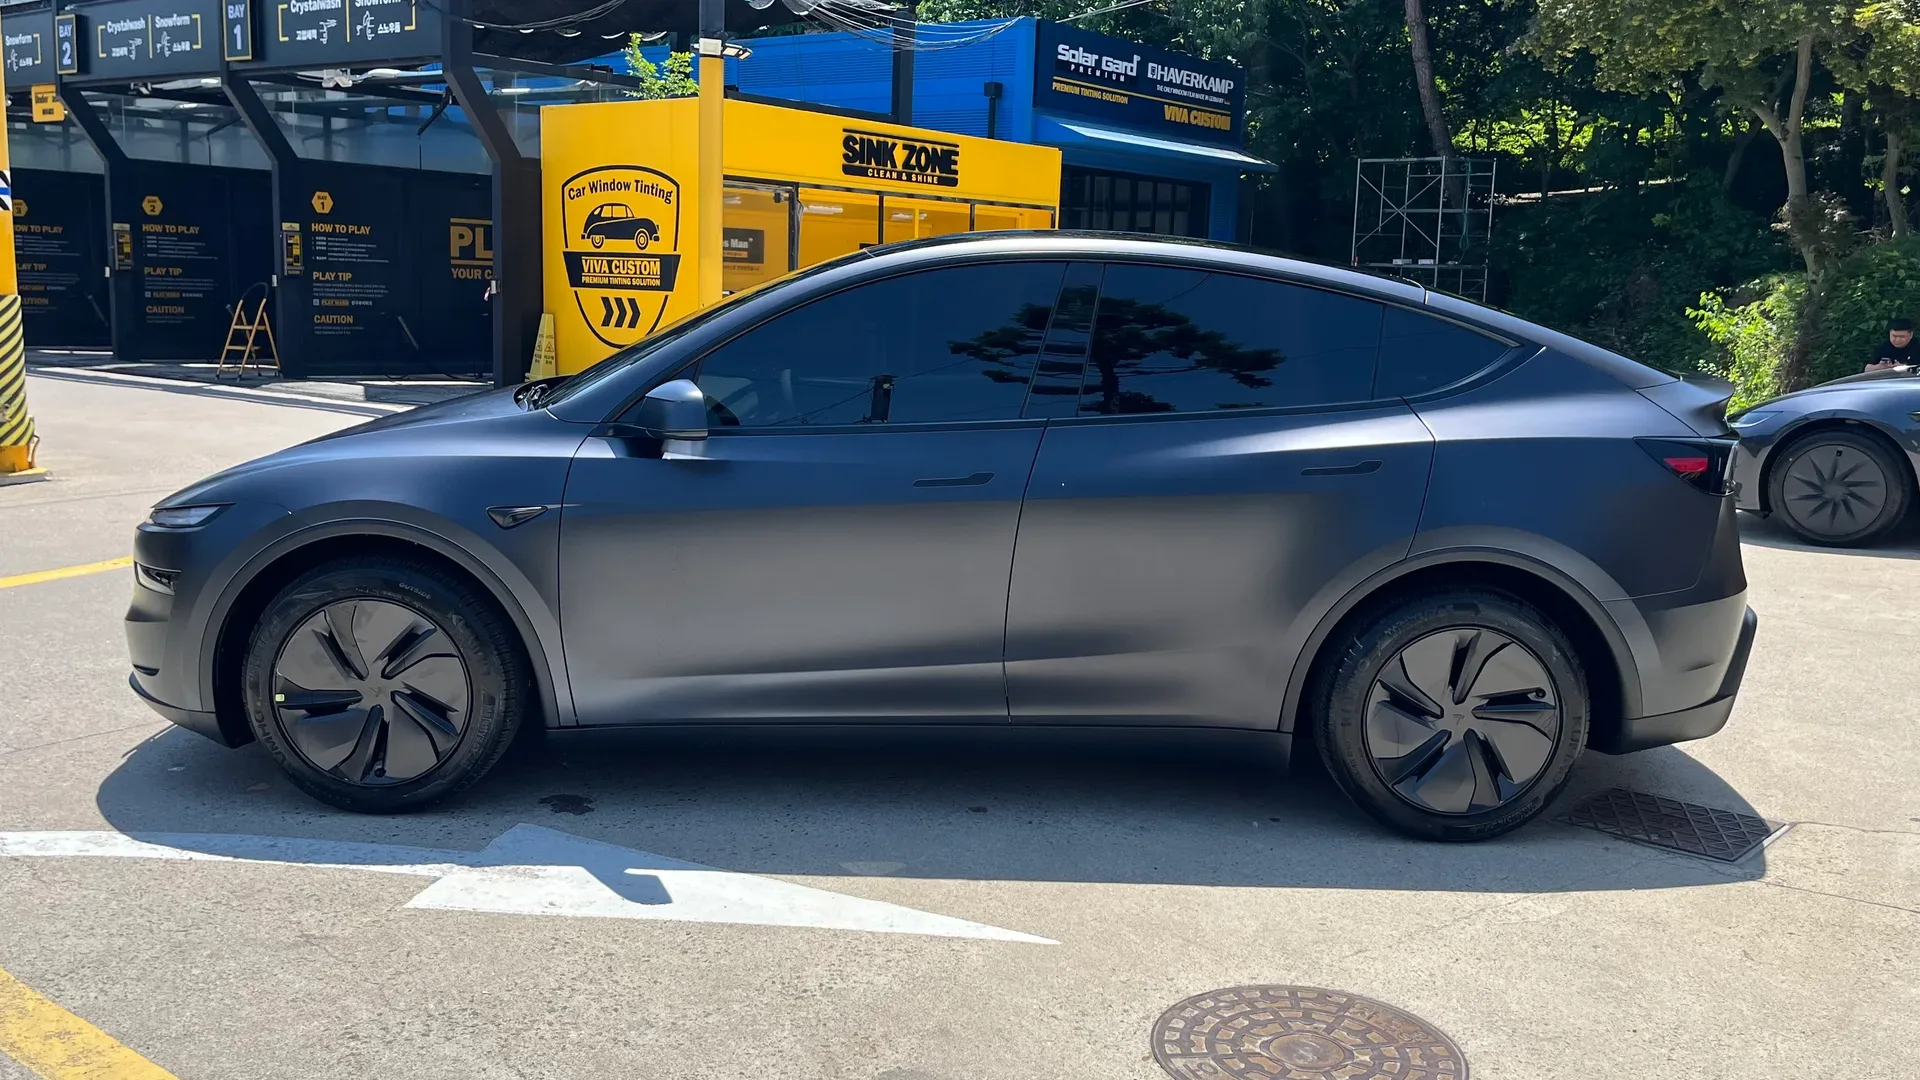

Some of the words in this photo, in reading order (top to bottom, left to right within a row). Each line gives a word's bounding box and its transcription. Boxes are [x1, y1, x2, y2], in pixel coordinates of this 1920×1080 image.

[227, 4, 245, 19] BAY
[106, 17, 146, 35] Crystalwash
[155, 13, 190, 28] Snowform
[59, 25, 72, 38] BAY
[233, 24, 242, 50] 1
[5, 33, 32, 46] Snowform
[62, 41, 71, 65] 2
[1057, 44, 1099, 67] Solar
[1101, 54, 1138, 76] Gard
[1070, 63, 1125, 82] PREMIUM
[1157, 65, 1234, 94] HAVERKAMP
[1052, 82, 1080, 95] PREMIUM
[1080, 87, 1102, 99] TINTING
[1102, 92, 1129, 104] SOLUTION
[1164, 104, 1189, 124] VIVA
[1190, 110, 1231, 131] CUSTOM
[842, 134, 898, 169] SINK
[902, 143, 960, 176] ZONE
[867, 168, 898, 180] CLEAN
[902, 172, 907, 180] &
[911, 173, 939, 184] SHINE
[568, 185, 587, 201] Car
[588, 178, 632, 194] Window
[634, 179, 674, 205] Tinting
[149, 204, 156, 212] 2
[320, 202, 325, 210] 1
[14, 224, 28, 232] OW
[30, 225, 41, 233] TO
[42, 226, 64, 234] PLAY
[142, 224, 163, 232] HOW
[165, 225, 176, 233] TO
[178, 225, 200, 234] PLAY
[311, 222, 334, 233] HOW
[334, 224, 347, 233] TO
[348, 225, 371, 235] PLAY
[144, 266, 166, 275] PLAY
[168, 267, 183, 276] TIP
[451, 268, 482, 279] YOUR
[581, 259, 610, 274] VIVA
[611, 260, 660, 275] CUSTOM
[312, 271, 336, 281] PLAY
[337, 272, 352, 281] TIP
[581, 276, 609, 284] PREMIUM
[609, 277, 631, 286] TINTING
[632, 278, 660, 287] SOLUTION
[22, 297, 49, 305] UTION
[145, 305, 185, 314] CAUTION
[313, 314, 353, 324] CAUTION
[398, 582, 432, 600] OUTSIDE
